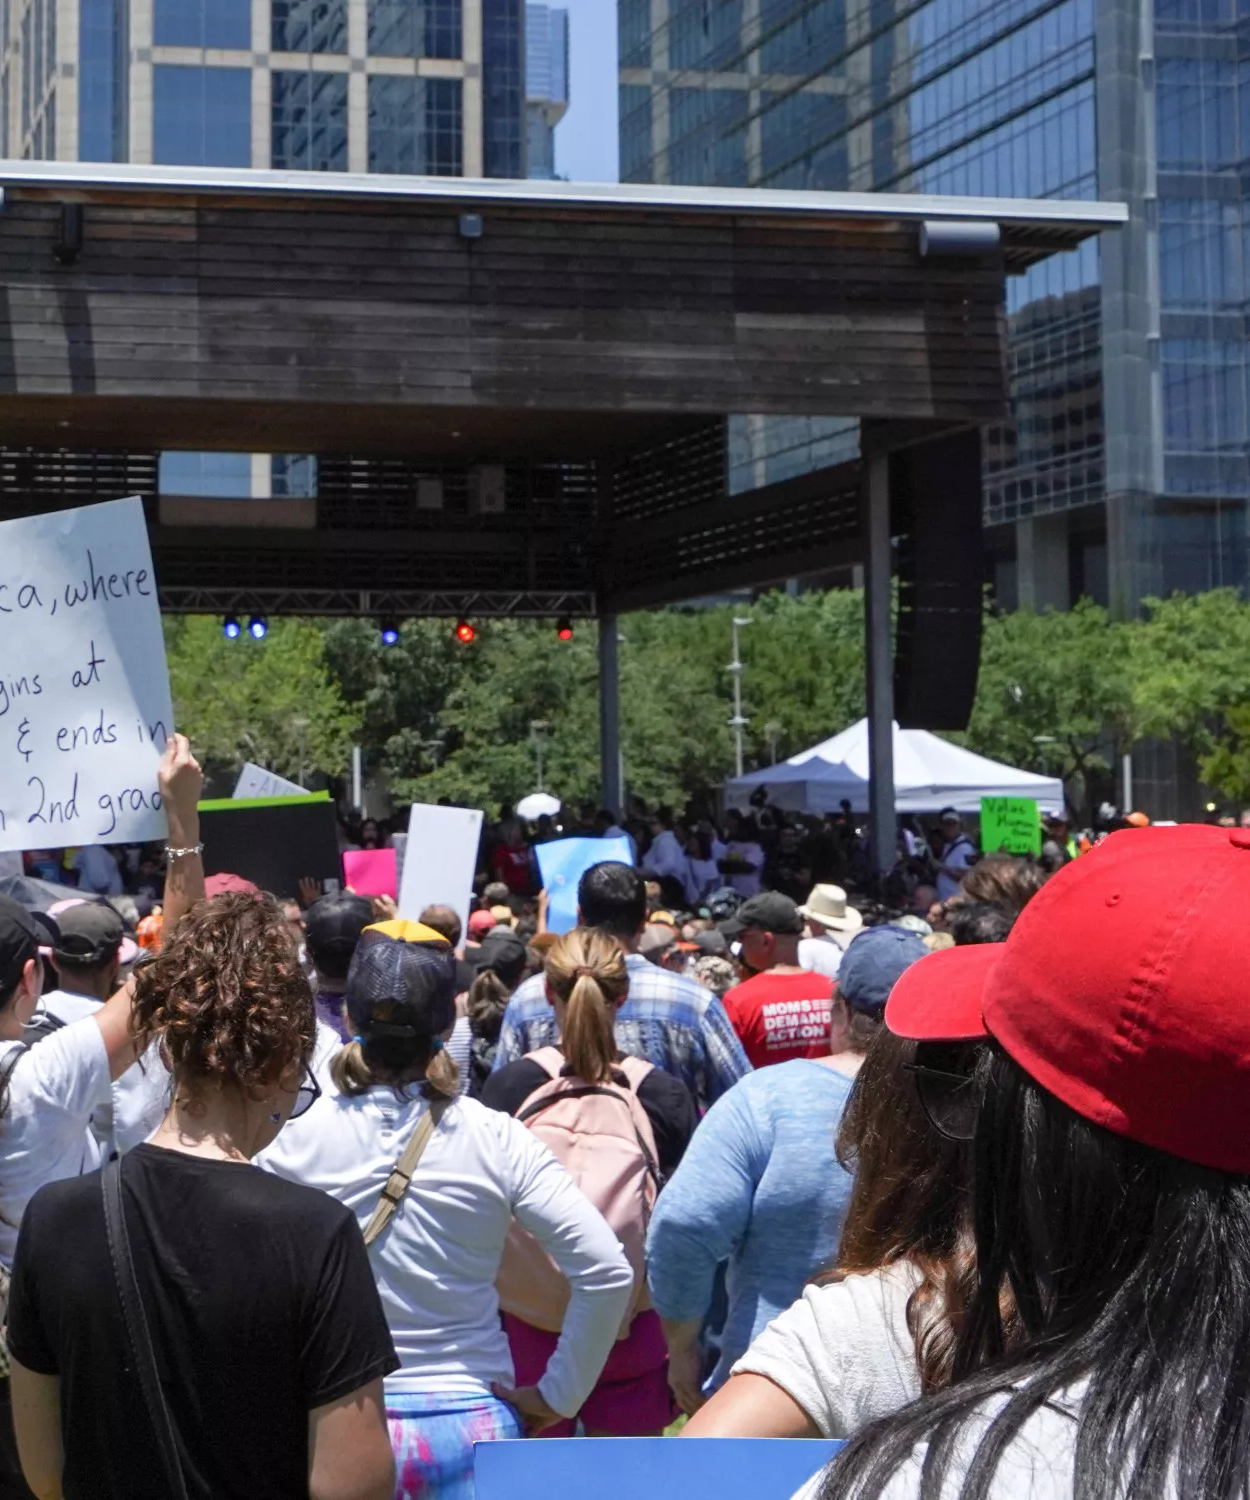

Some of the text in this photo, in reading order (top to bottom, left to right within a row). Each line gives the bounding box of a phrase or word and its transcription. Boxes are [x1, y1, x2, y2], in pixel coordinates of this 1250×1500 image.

[64, 548, 151, 608] where
[71, 640, 106, 688] at
[16, 717, 34, 763] &
[56, 708, 118, 752] ends
[136, 718, 168, 744] in
[27, 771, 80, 824] 2nd
[762, 1000, 812, 1016] MOMS
[764, 1010, 832, 1030] DEMAND
[766, 1025, 825, 1043] ACTION
